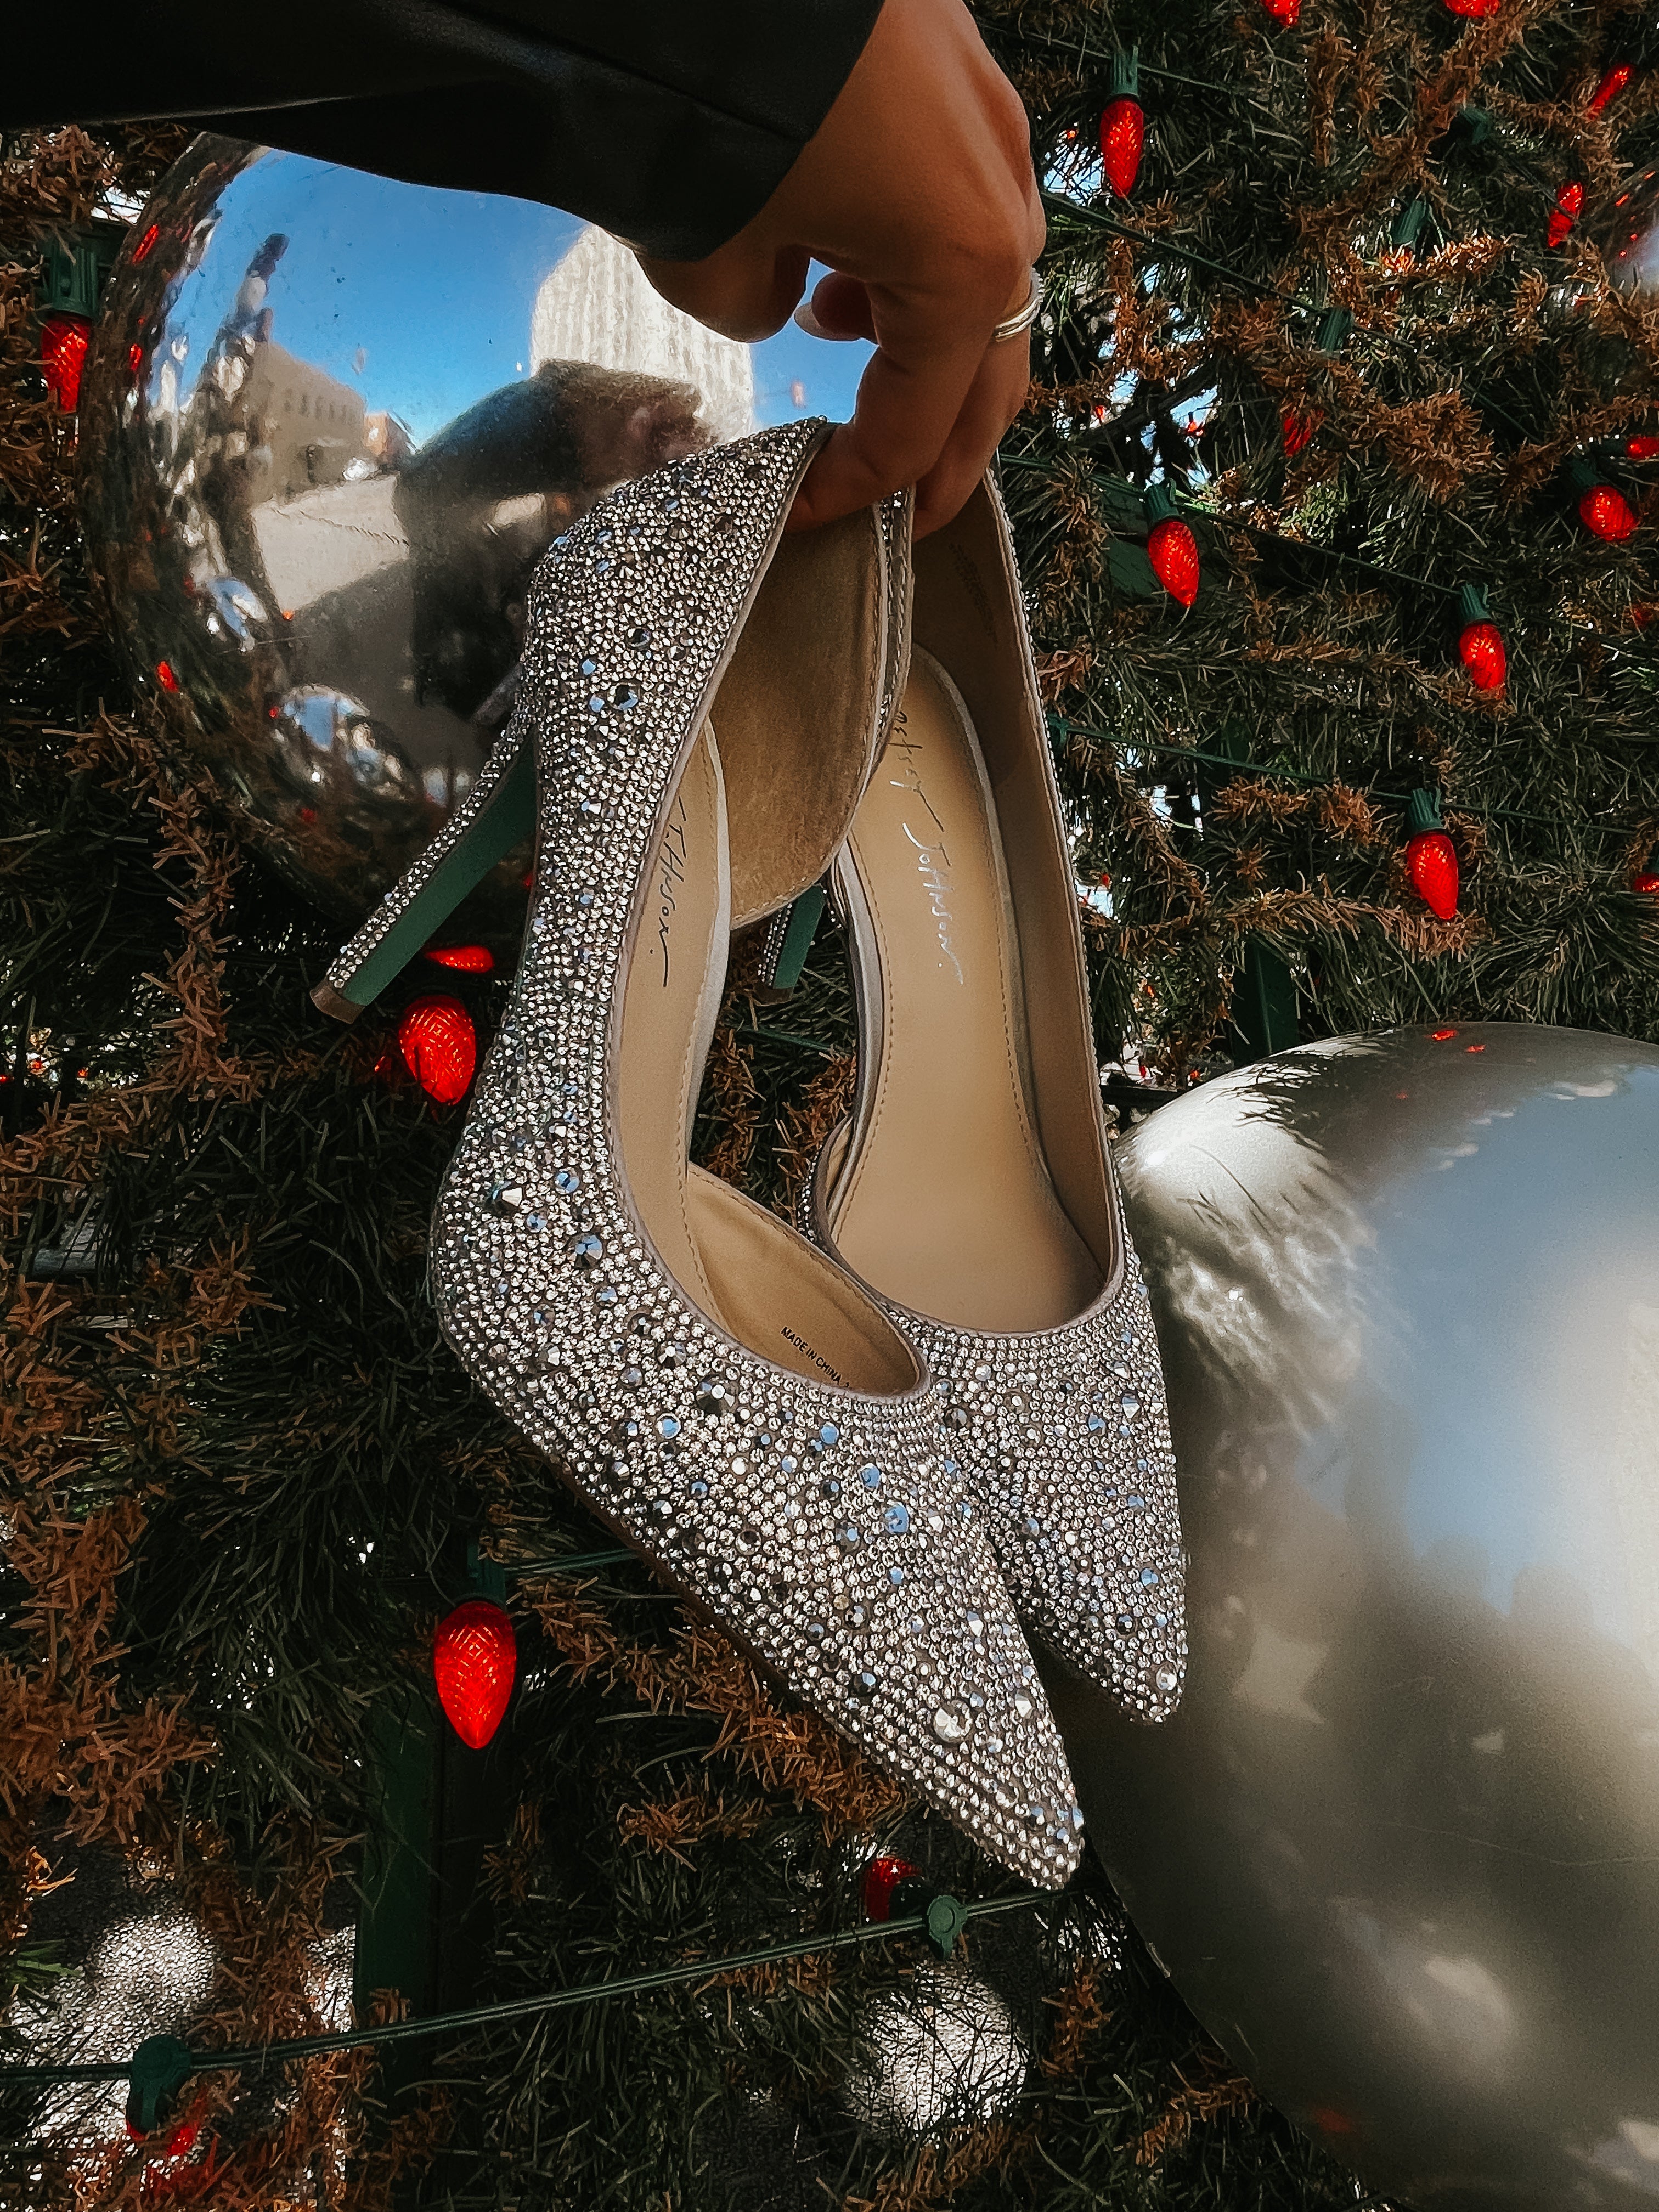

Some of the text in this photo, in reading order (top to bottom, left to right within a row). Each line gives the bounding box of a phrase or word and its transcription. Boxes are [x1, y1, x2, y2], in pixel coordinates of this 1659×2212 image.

[780, 1327, 842, 1385] MADE IN CHINA
